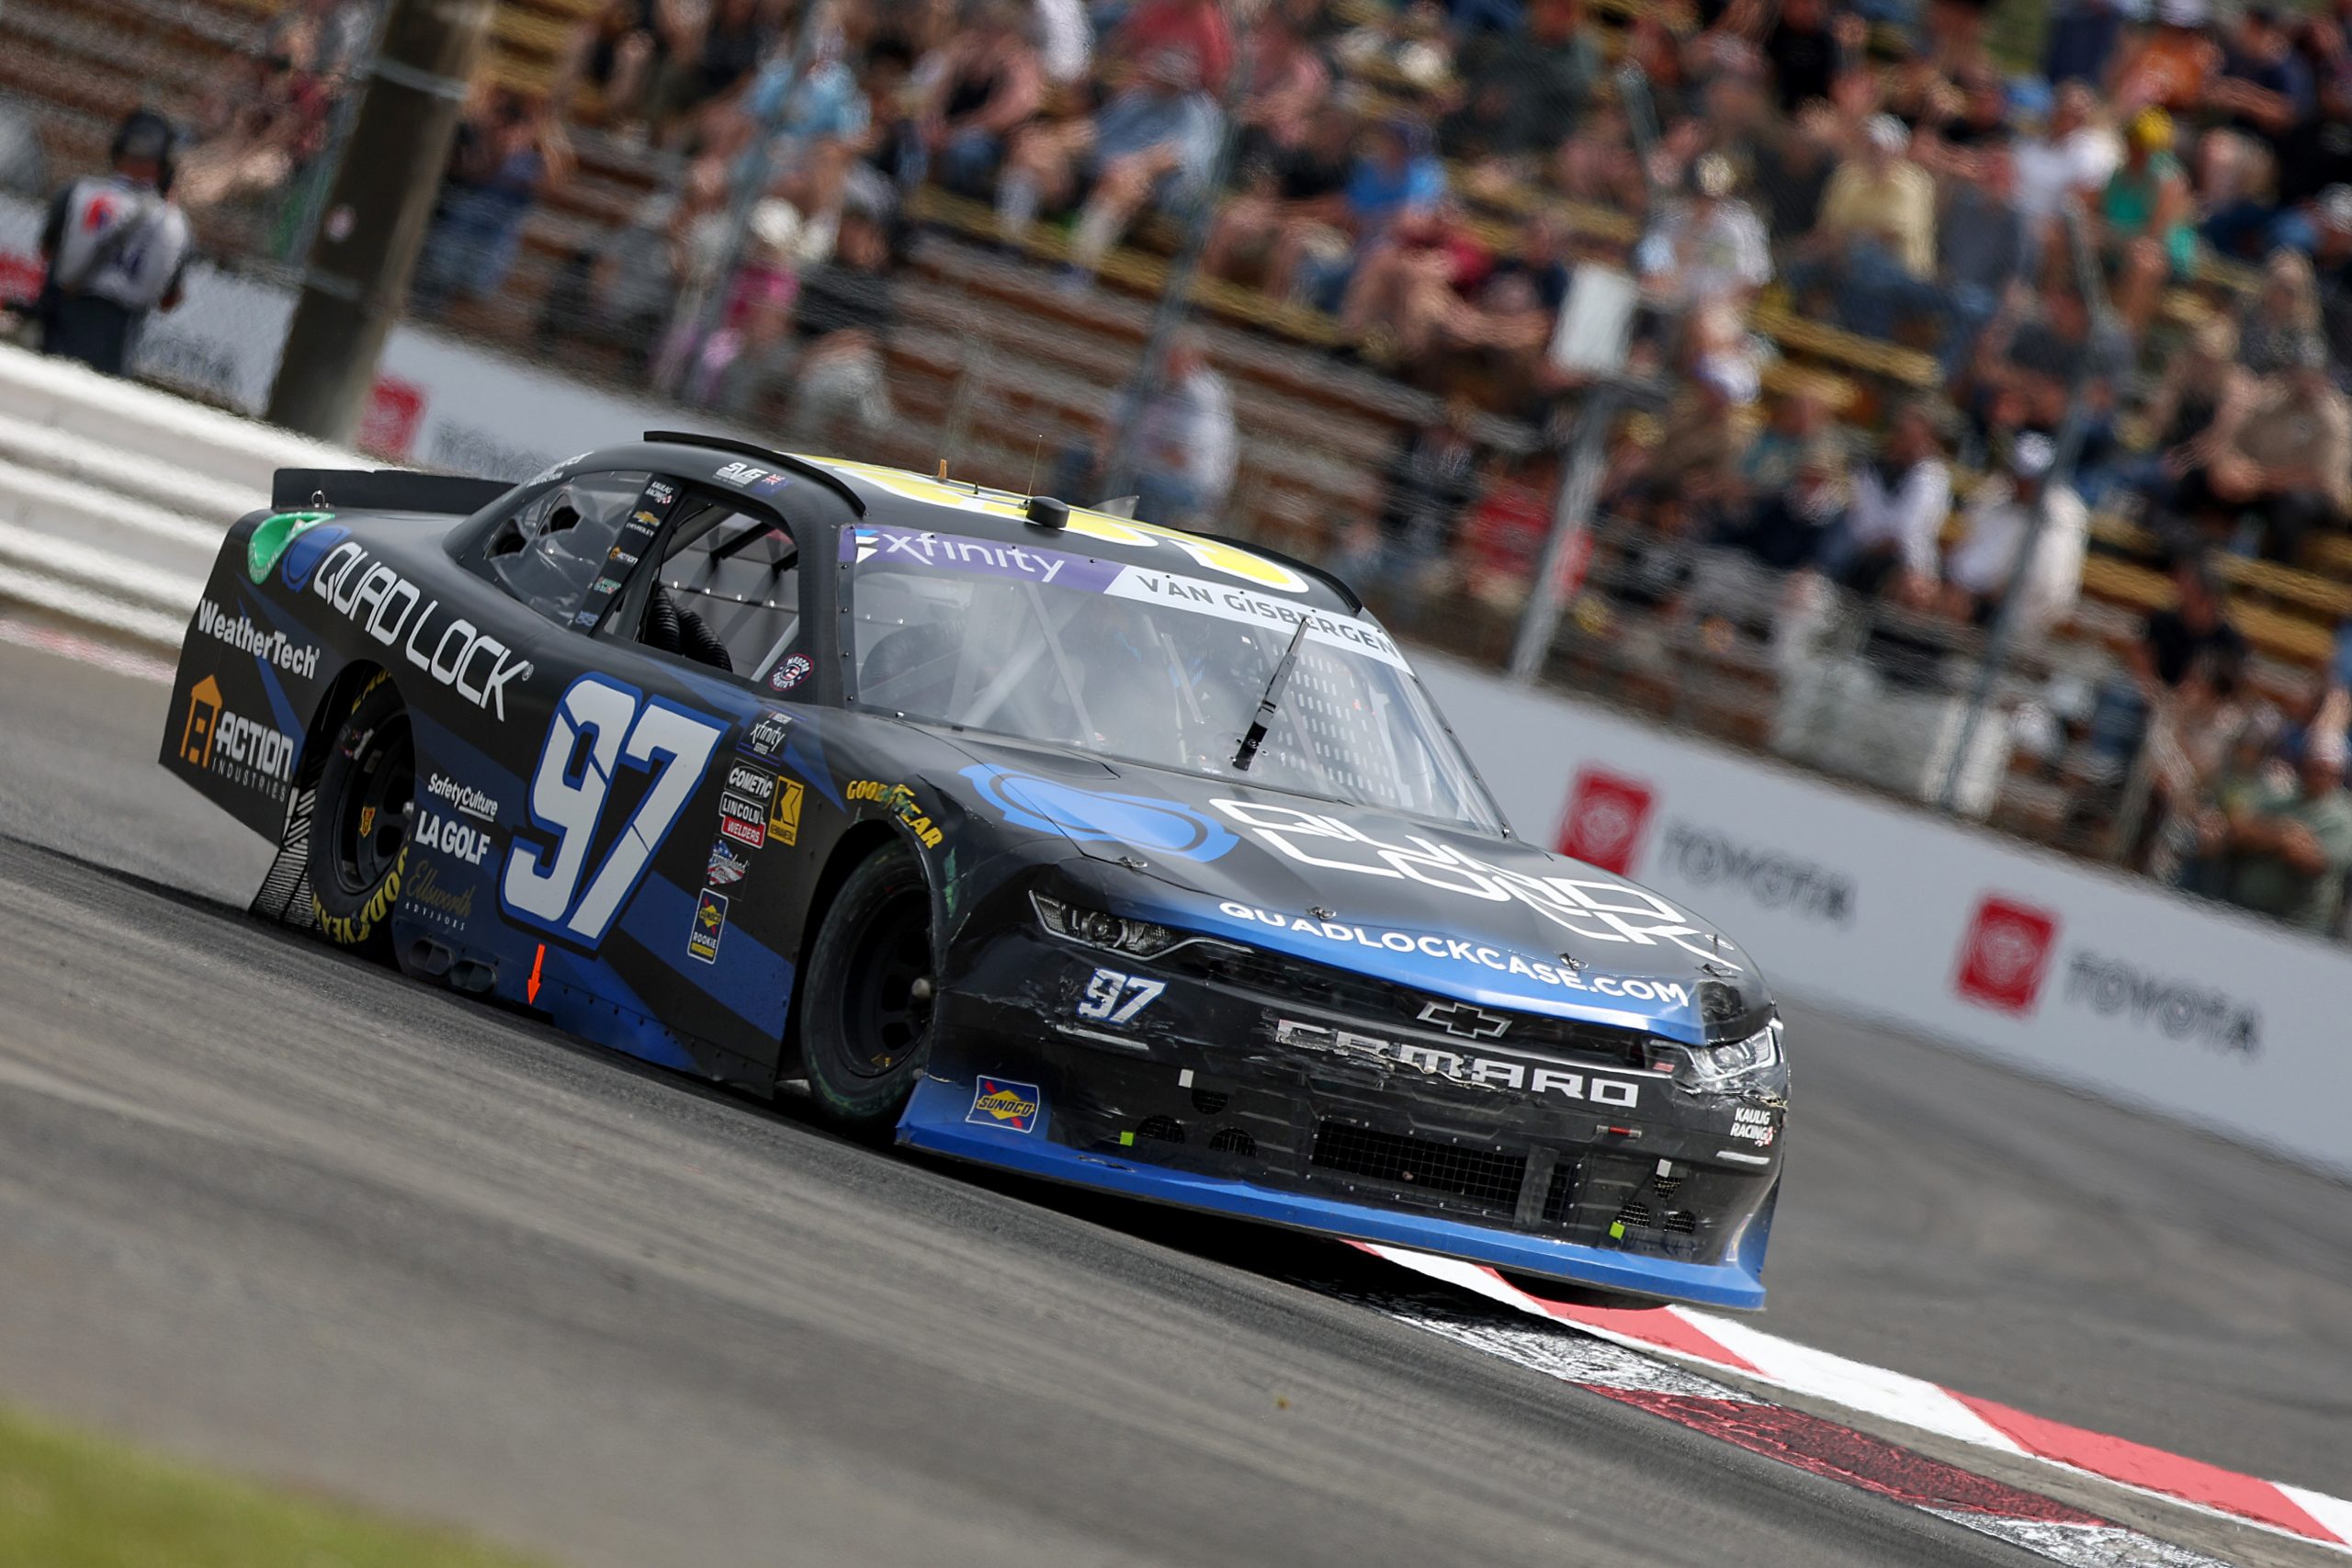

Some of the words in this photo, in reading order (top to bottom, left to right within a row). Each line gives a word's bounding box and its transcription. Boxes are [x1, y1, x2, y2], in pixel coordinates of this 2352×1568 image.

[882, 532, 1065, 582] xfinity
[198, 597, 318, 680] WeatherTech
[313, 541, 420, 646] QUAD
[405, 599, 530, 722] LOCK
[1136, 574, 1215, 604] VAN
[1223, 592, 1401, 660] GISBERGEN
[215, 710, 294, 783] ACTION
[211, 756, 287, 803] INDUSTRIES
[427, 773, 498, 817] SafetyCulture
[729, 767, 773, 798] COMETIC
[501, 675, 728, 944] 97
[722, 797, 761, 824] LINCOLN
[727, 819, 761, 843] WELDERS
[414, 810, 440, 850] LA
[440, 820, 492, 865] GOLF
[404, 901, 466, 931] ADVISORS
[693, 931, 717, 949] ROOKIE
[1218, 901, 1690, 1008] QUADLOCKCASE.COM
[1077, 967, 1167, 1024] 97
[2067, 952, 2262, 1058] TOYOTA
[1275, 1019, 1638, 1108] CAMARO
[978, 1096, 1035, 1116] SUNOCO
[1730, 1122, 1769, 1140] RACING
[1735, 1107, 1771, 1125] KAULIG
